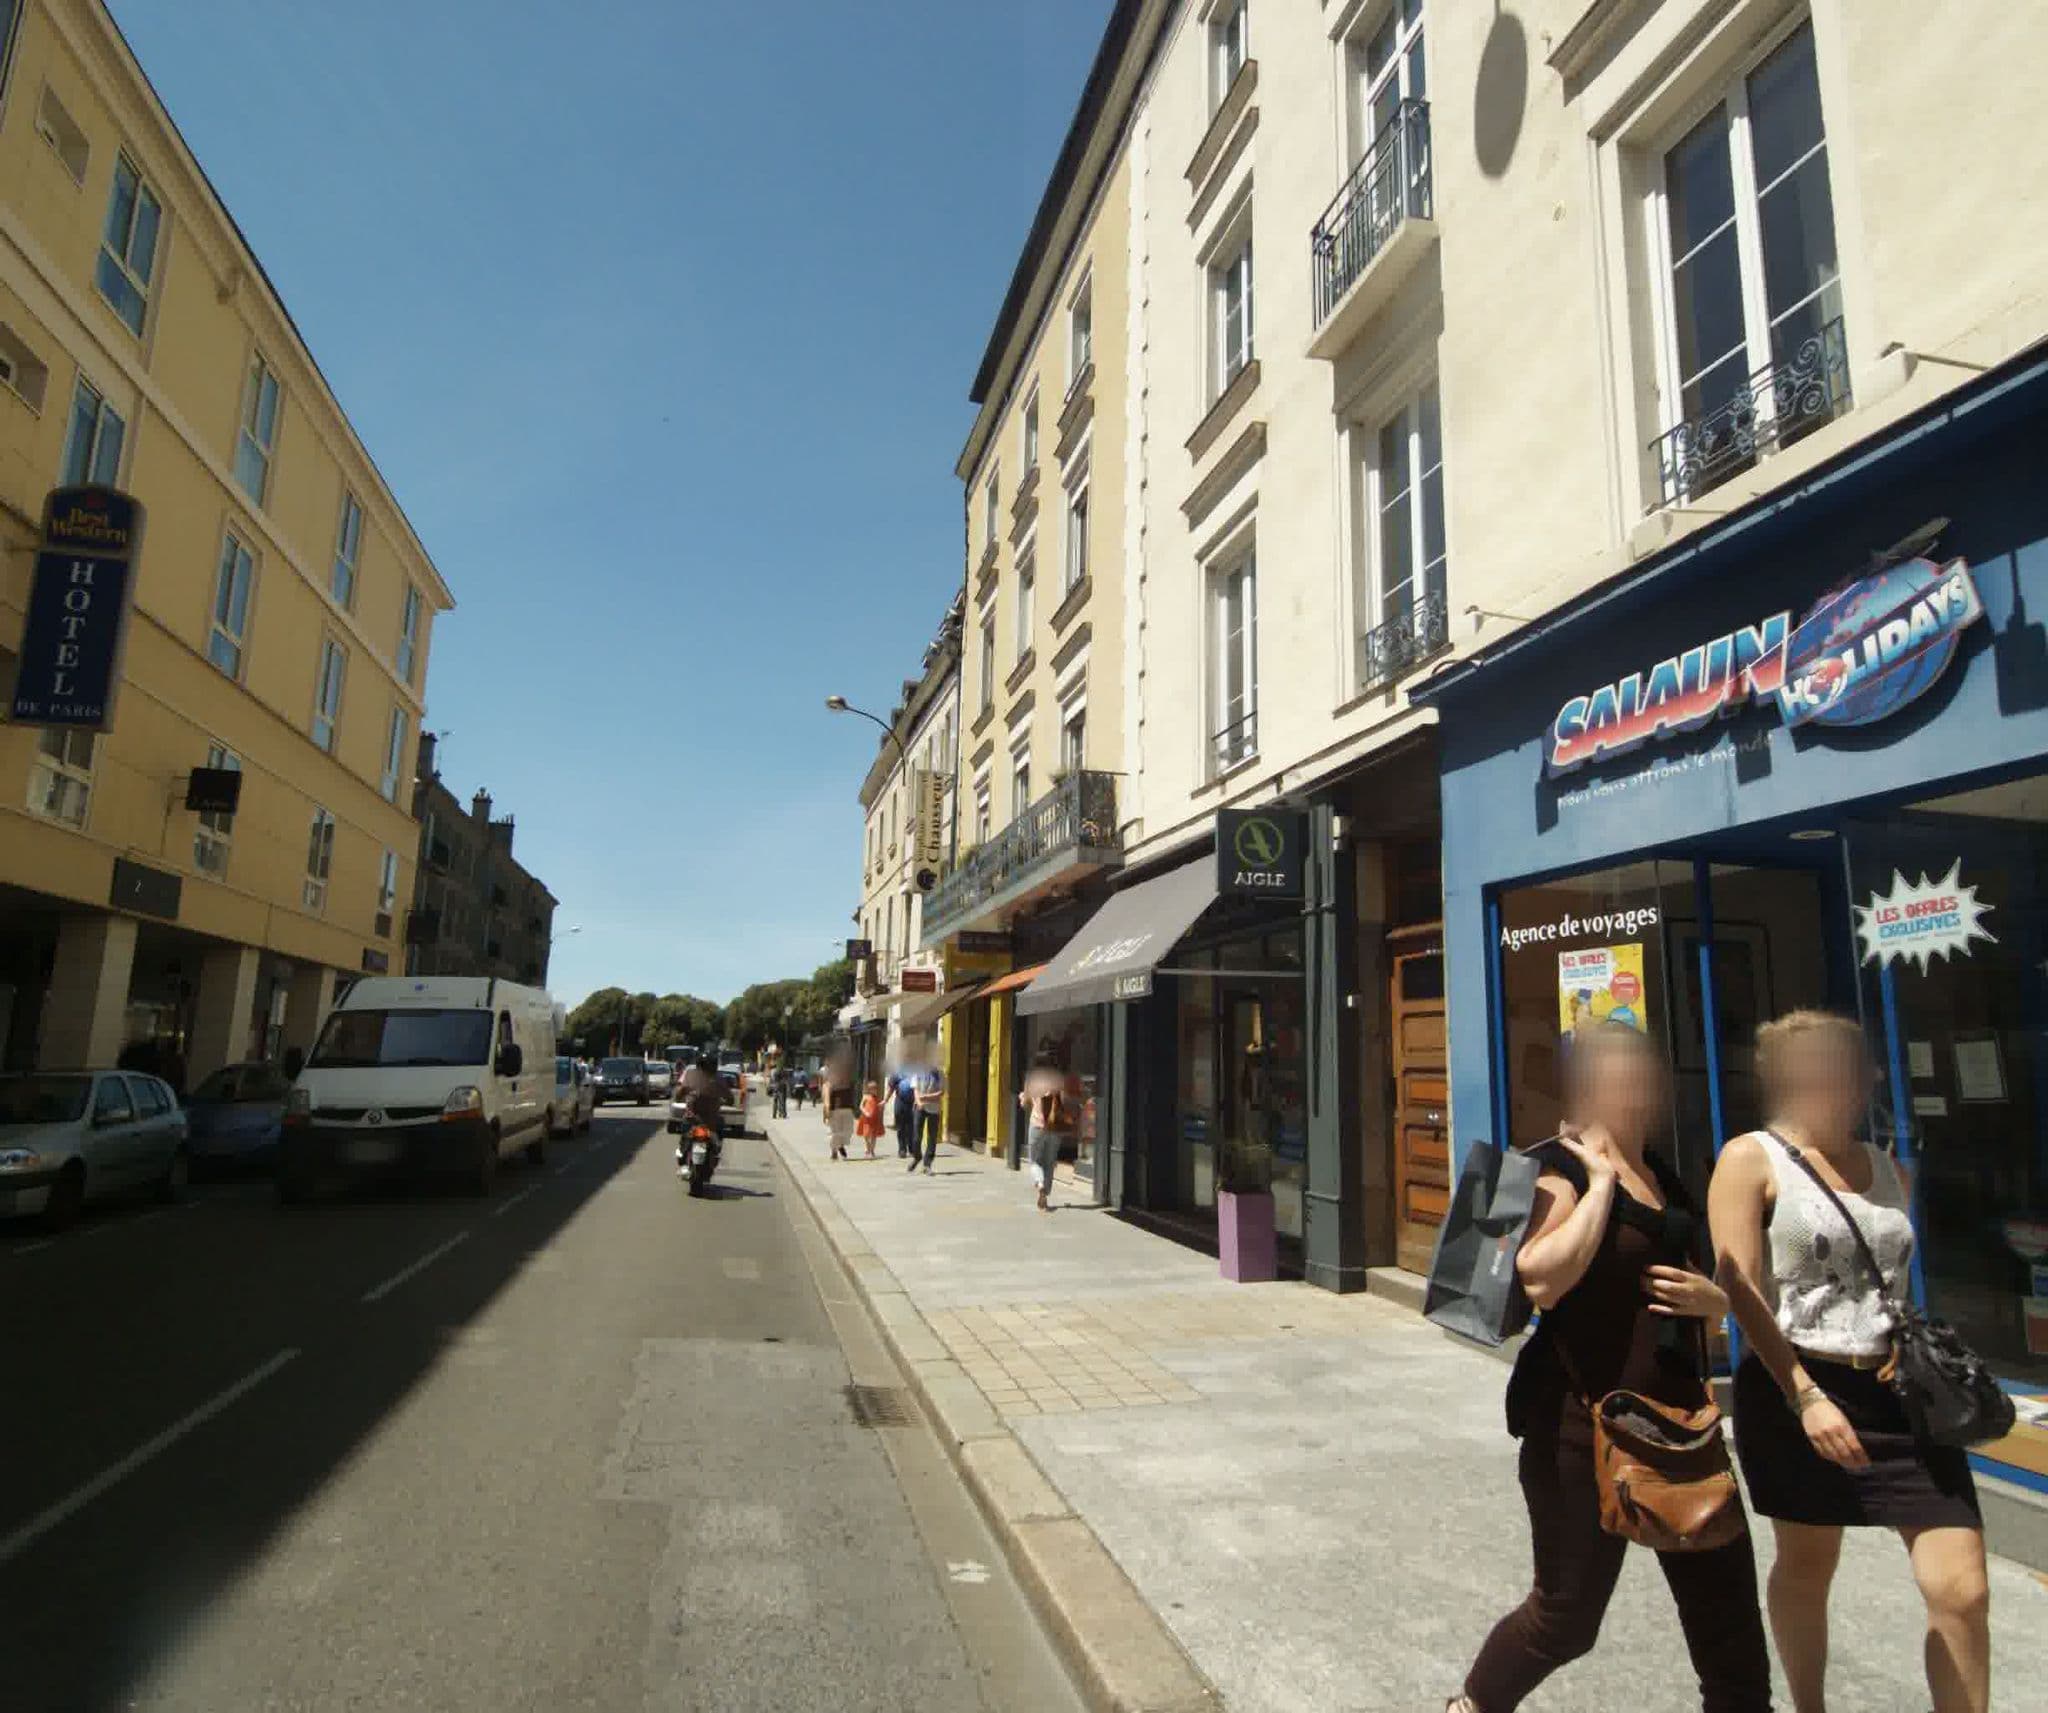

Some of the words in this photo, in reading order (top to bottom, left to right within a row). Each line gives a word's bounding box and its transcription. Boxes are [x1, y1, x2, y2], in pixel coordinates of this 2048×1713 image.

[52, 518, 127, 543] Western
[53, 561, 95, 696] HOTEL
[1781, 573, 1968, 712] HOLIDAYS
[50, 704, 101, 718] PARIS
[1234, 871, 1286, 887] AIGLE
[1875, 907, 1899, 924] LES
[1501, 926, 1557, 951] Agence
[1559, 913, 1580, 937] de
[1582, 907, 1658, 938] voyages
